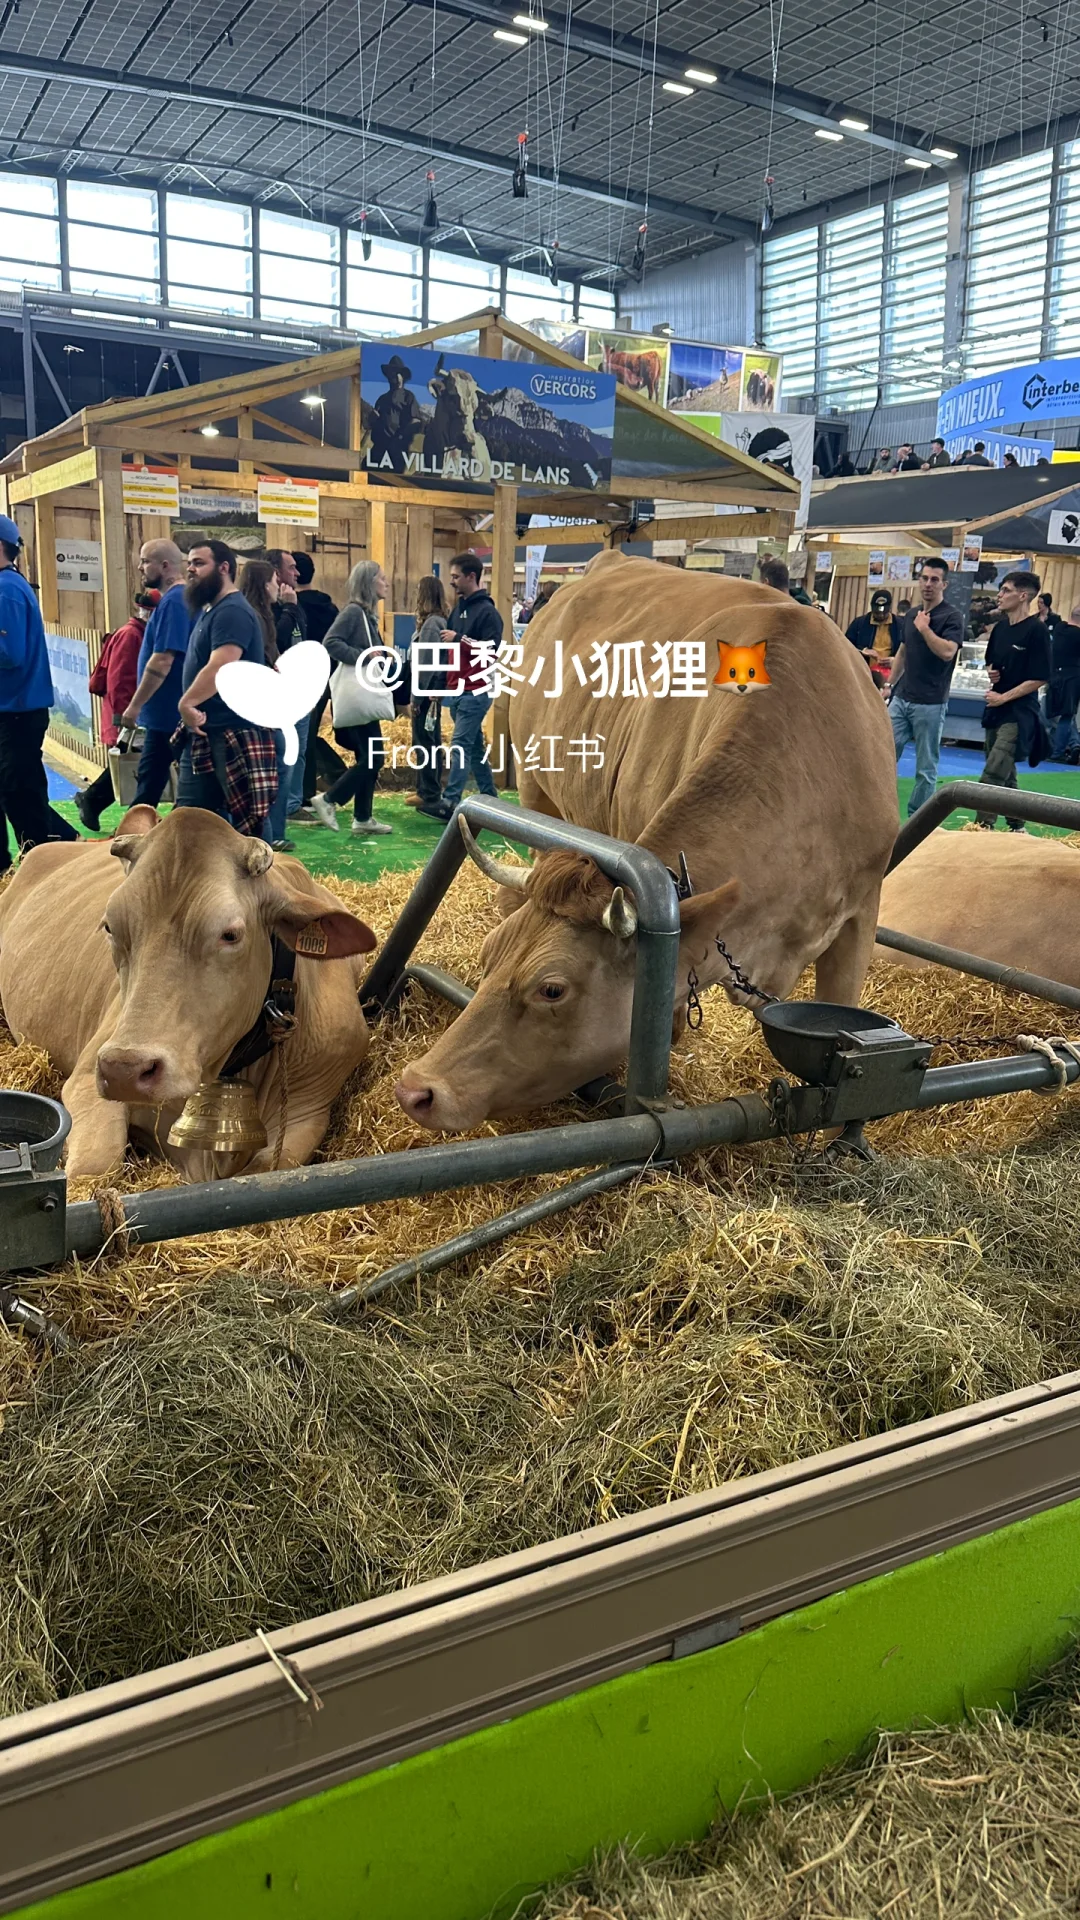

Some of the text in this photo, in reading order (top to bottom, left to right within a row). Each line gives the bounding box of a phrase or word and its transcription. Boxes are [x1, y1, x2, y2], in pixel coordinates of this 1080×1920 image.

[534, 378, 597, 400] VERCORS
[548, 374, 595, 385] inspiration
[956, 381, 1005, 429] MIEUX.
[366, 447, 570, 486] LA VILLARD DE LANS
[75, 554, 99, 562] Région
[299, 936, 325, 953] 1008
